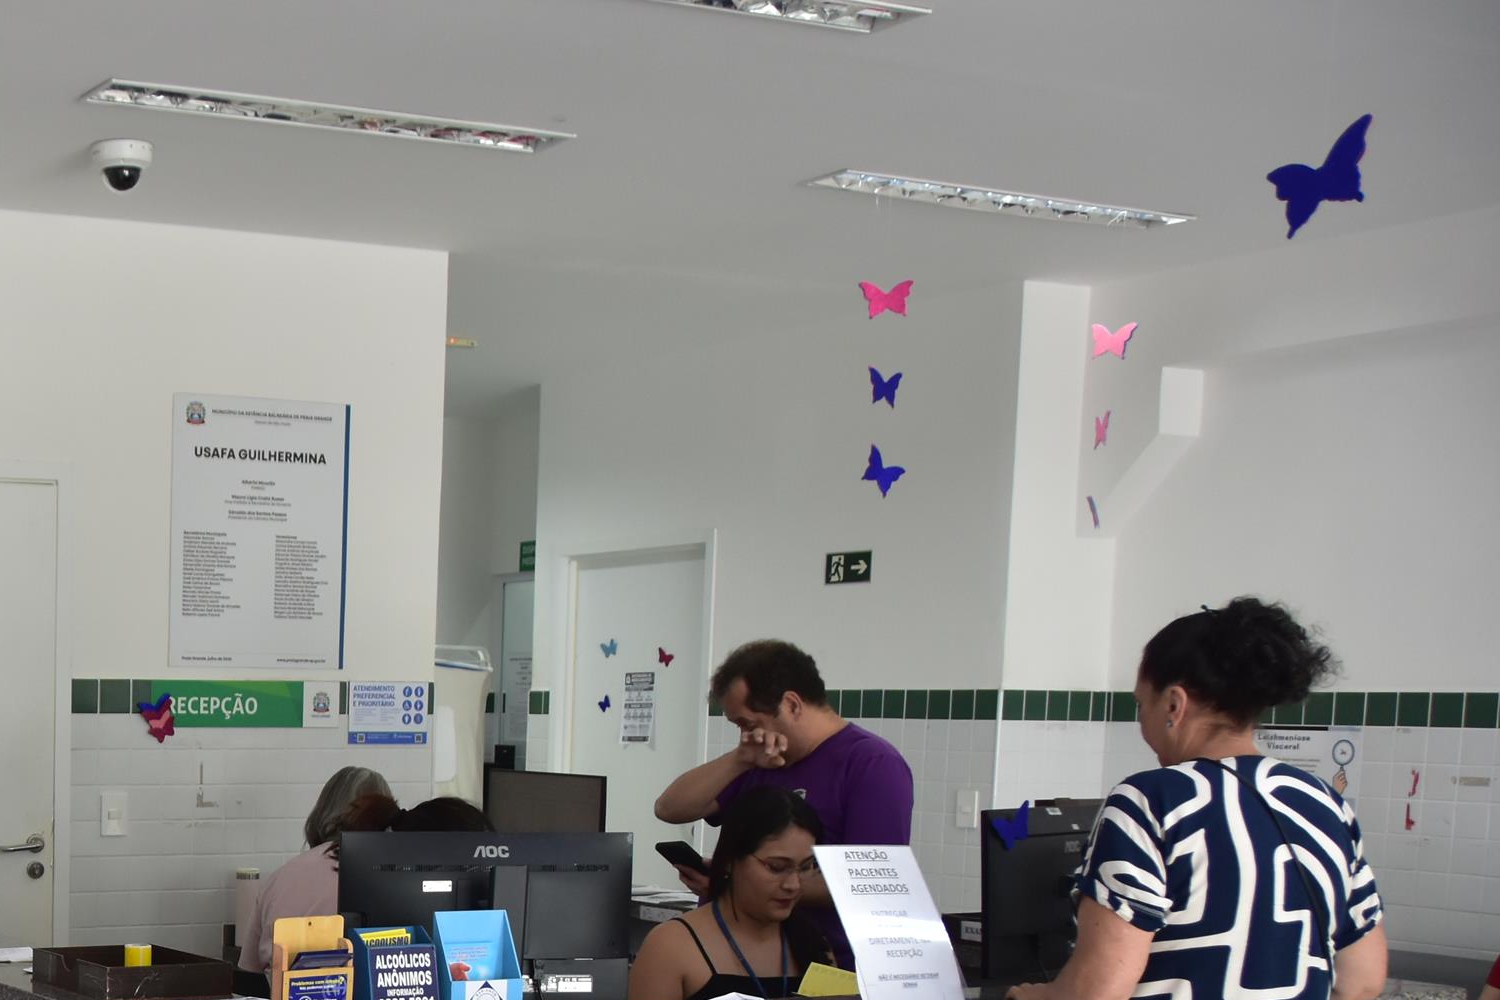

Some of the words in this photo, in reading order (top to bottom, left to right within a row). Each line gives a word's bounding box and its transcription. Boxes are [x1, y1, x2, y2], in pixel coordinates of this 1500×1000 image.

[194, 445, 235, 460] USAFA
[238, 448, 327, 465] GUILHERMINA
[353, 692, 396, 700] PREFERENCIAL
[169, 692, 258, 719] RECEPÇÃO
[1267, 742, 1300, 750] Visceral
[473, 845, 510, 858] AOC
[844, 849, 888, 861] ATENÇÃO
[848, 868, 898, 877] PACIENTES
[851, 884, 909, 893] AGENDADOS
[886, 947, 924, 958] RECEPÇÃO
[375, 951, 431, 969] ALCOÓLICOS
[377, 969, 432, 988] ANÔNIMOS
[387, 987, 424, 996] INFORMAÇÃO
